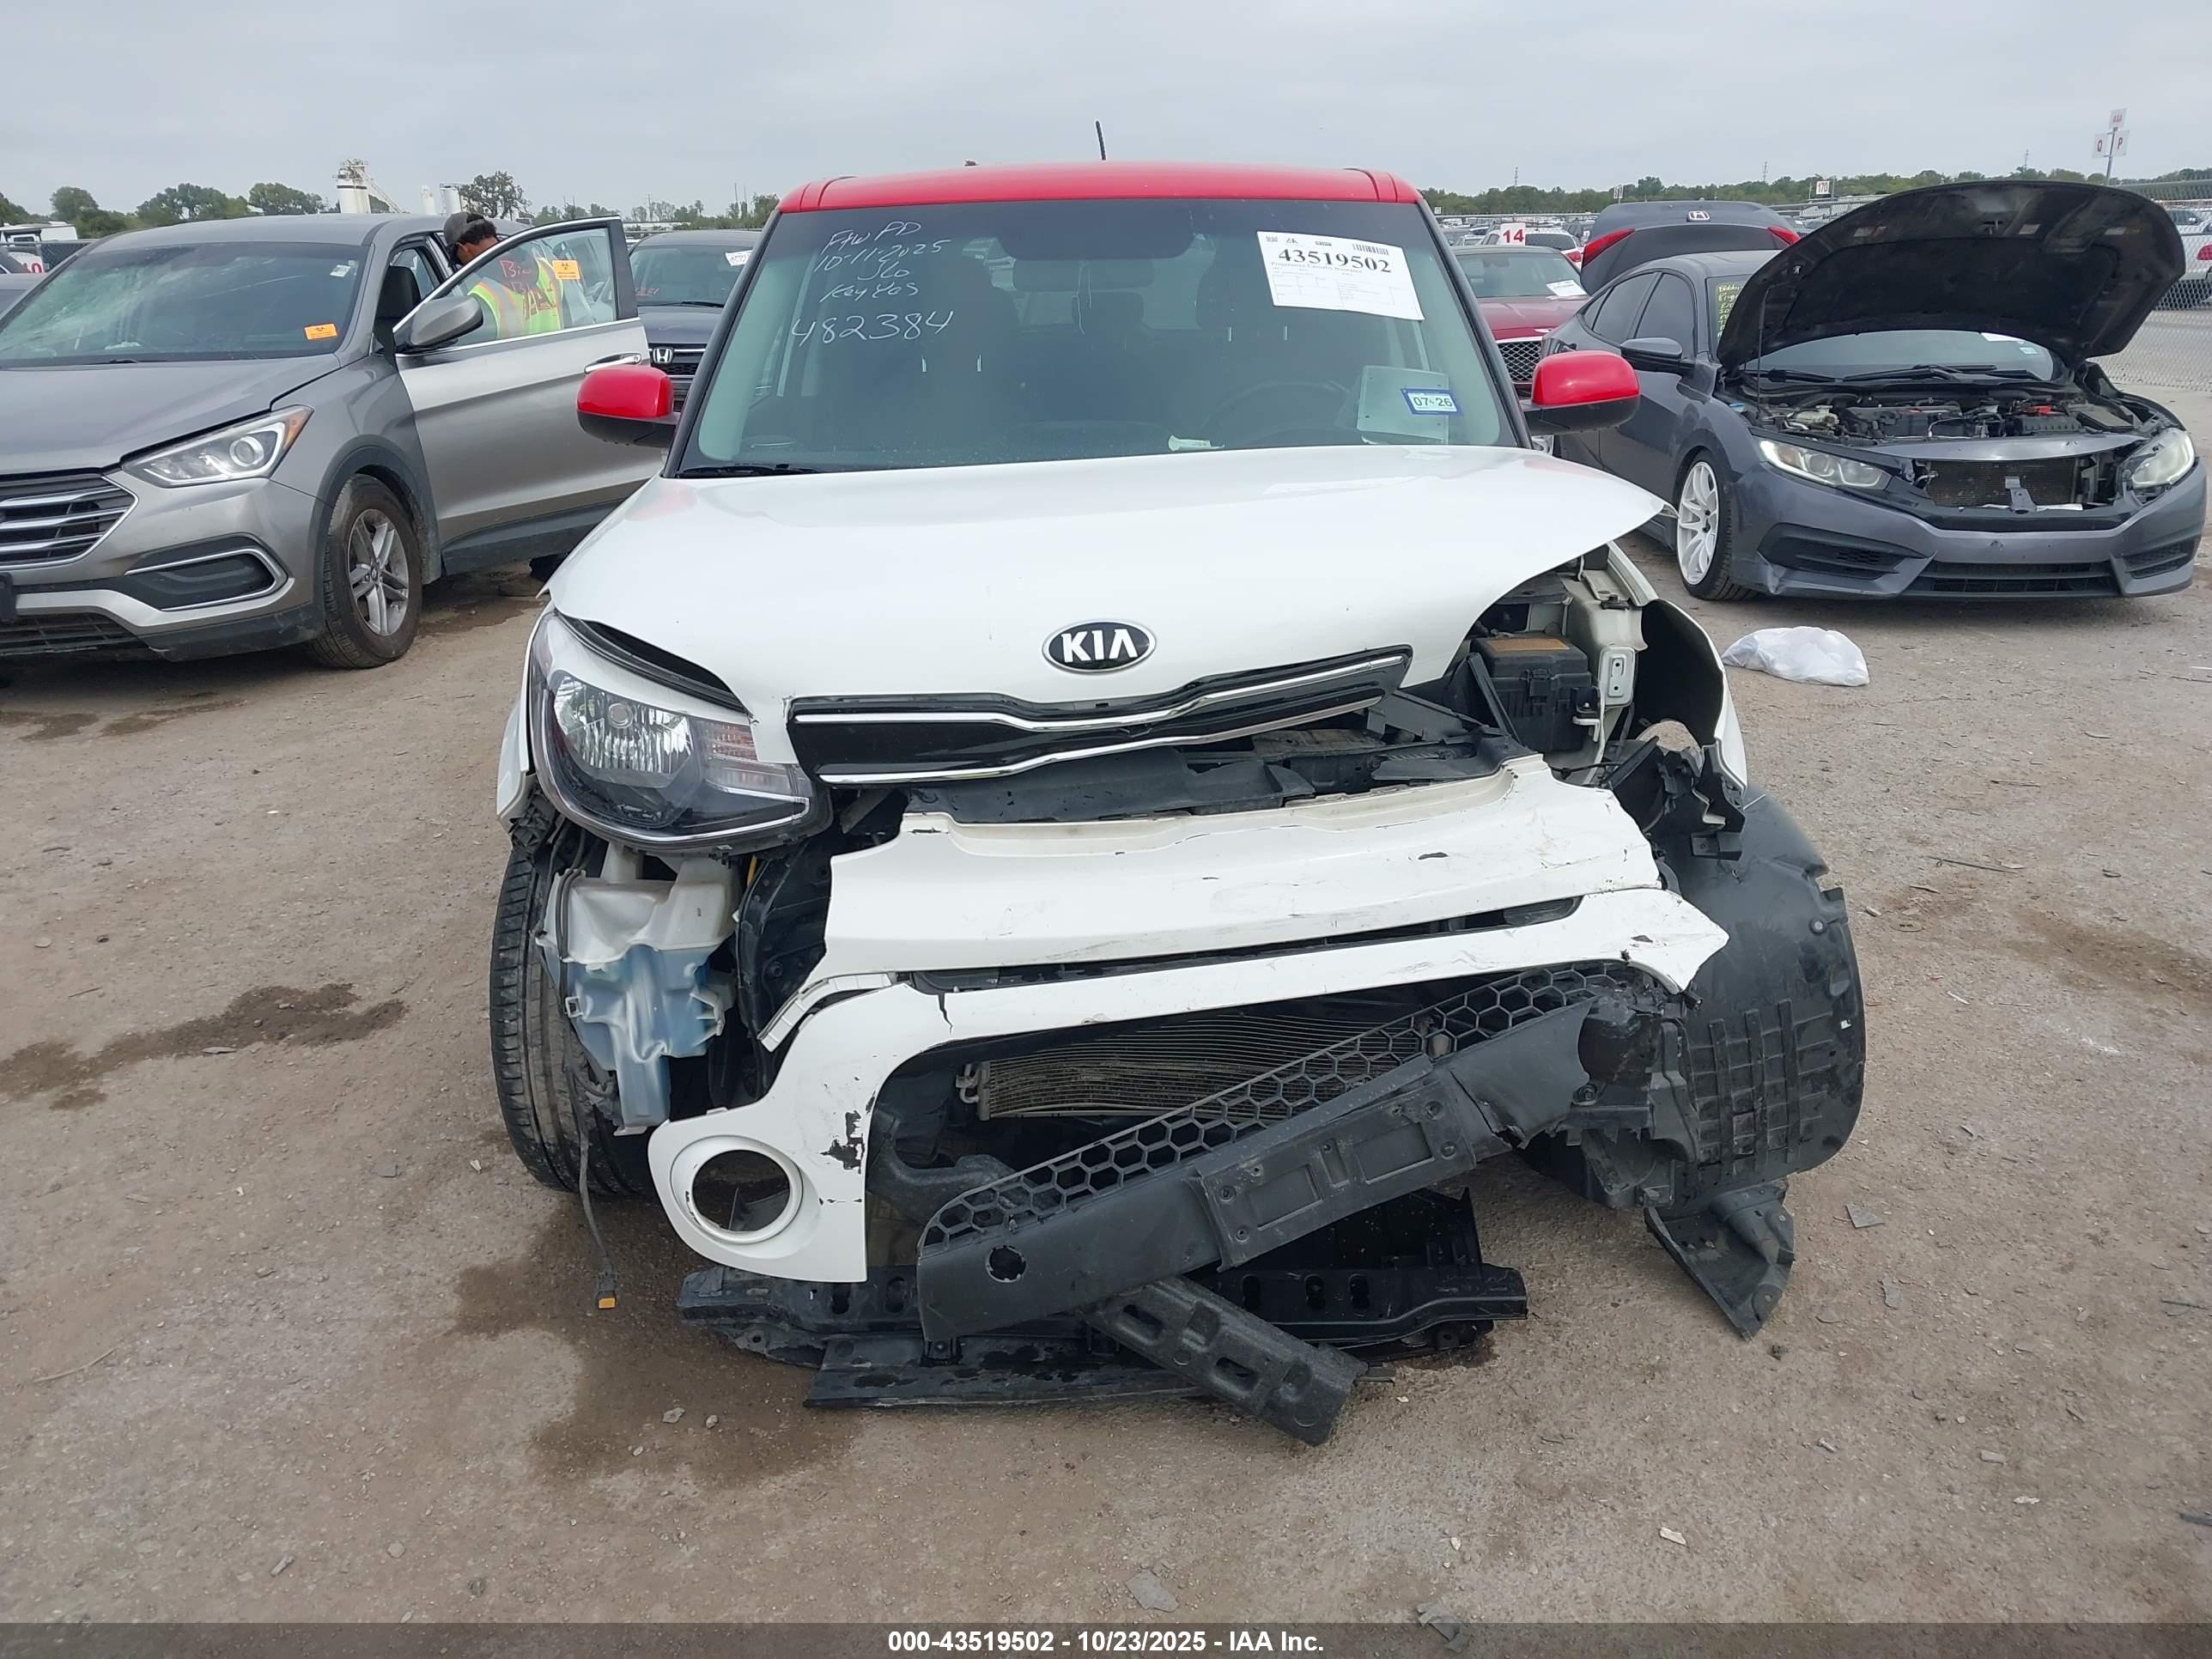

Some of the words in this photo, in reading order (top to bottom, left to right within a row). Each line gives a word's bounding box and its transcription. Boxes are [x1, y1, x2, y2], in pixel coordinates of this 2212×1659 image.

[1503, 228, 1525, 243] 14
[814, 240, 951, 272] 10-11-2025
[1278, 247, 1392, 273] 43519502
[791, 310, 954, 347] 482384
[1060, 629, 1139, 663] KIA
